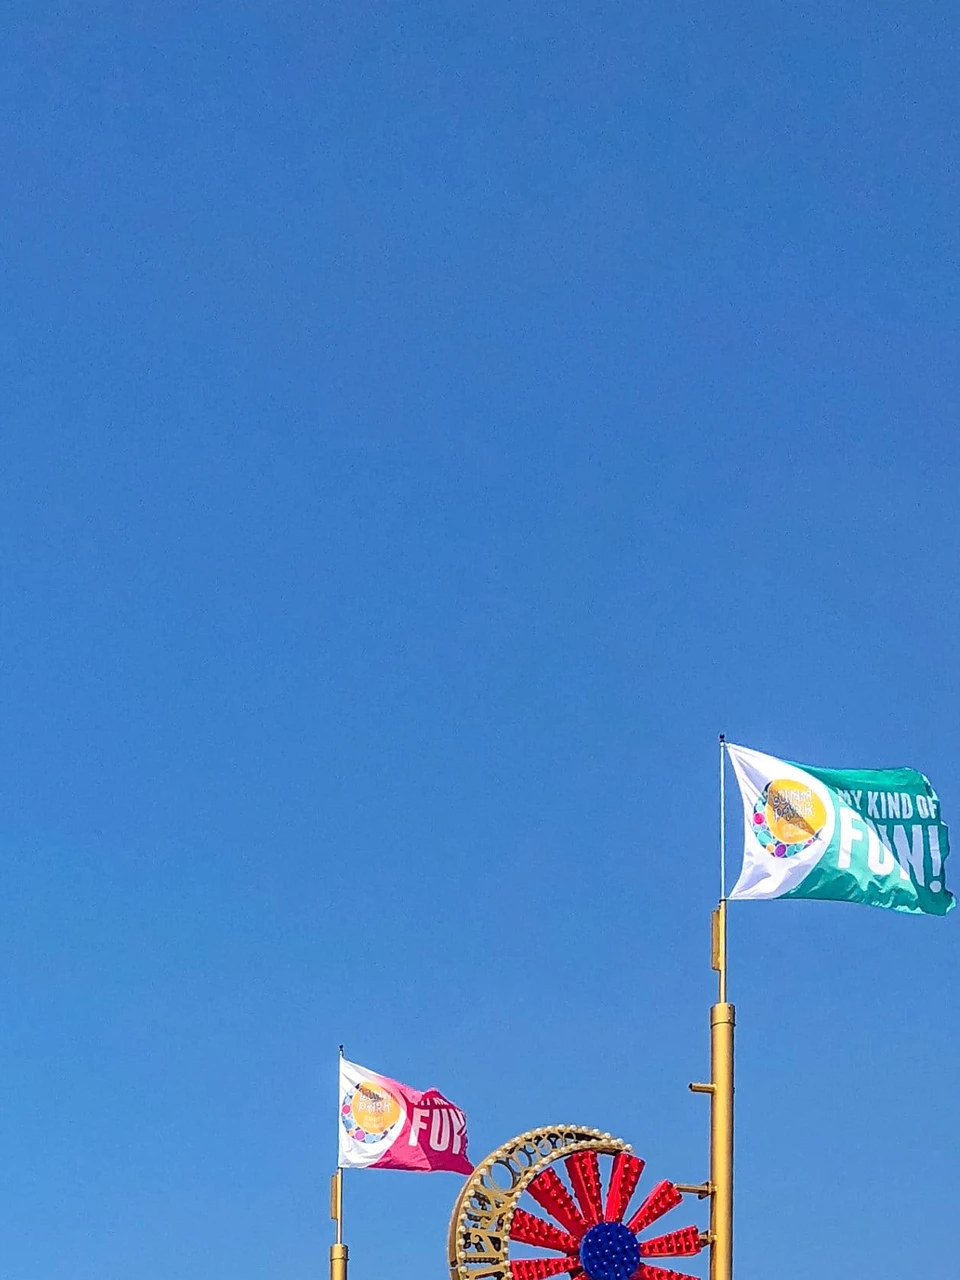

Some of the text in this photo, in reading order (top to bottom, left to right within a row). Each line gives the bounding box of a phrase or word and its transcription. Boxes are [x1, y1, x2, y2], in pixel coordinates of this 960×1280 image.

[868, 791, 912, 819] KIND
[916, 795, 938, 820] OF
[839, 807, 942, 893] FUN!
